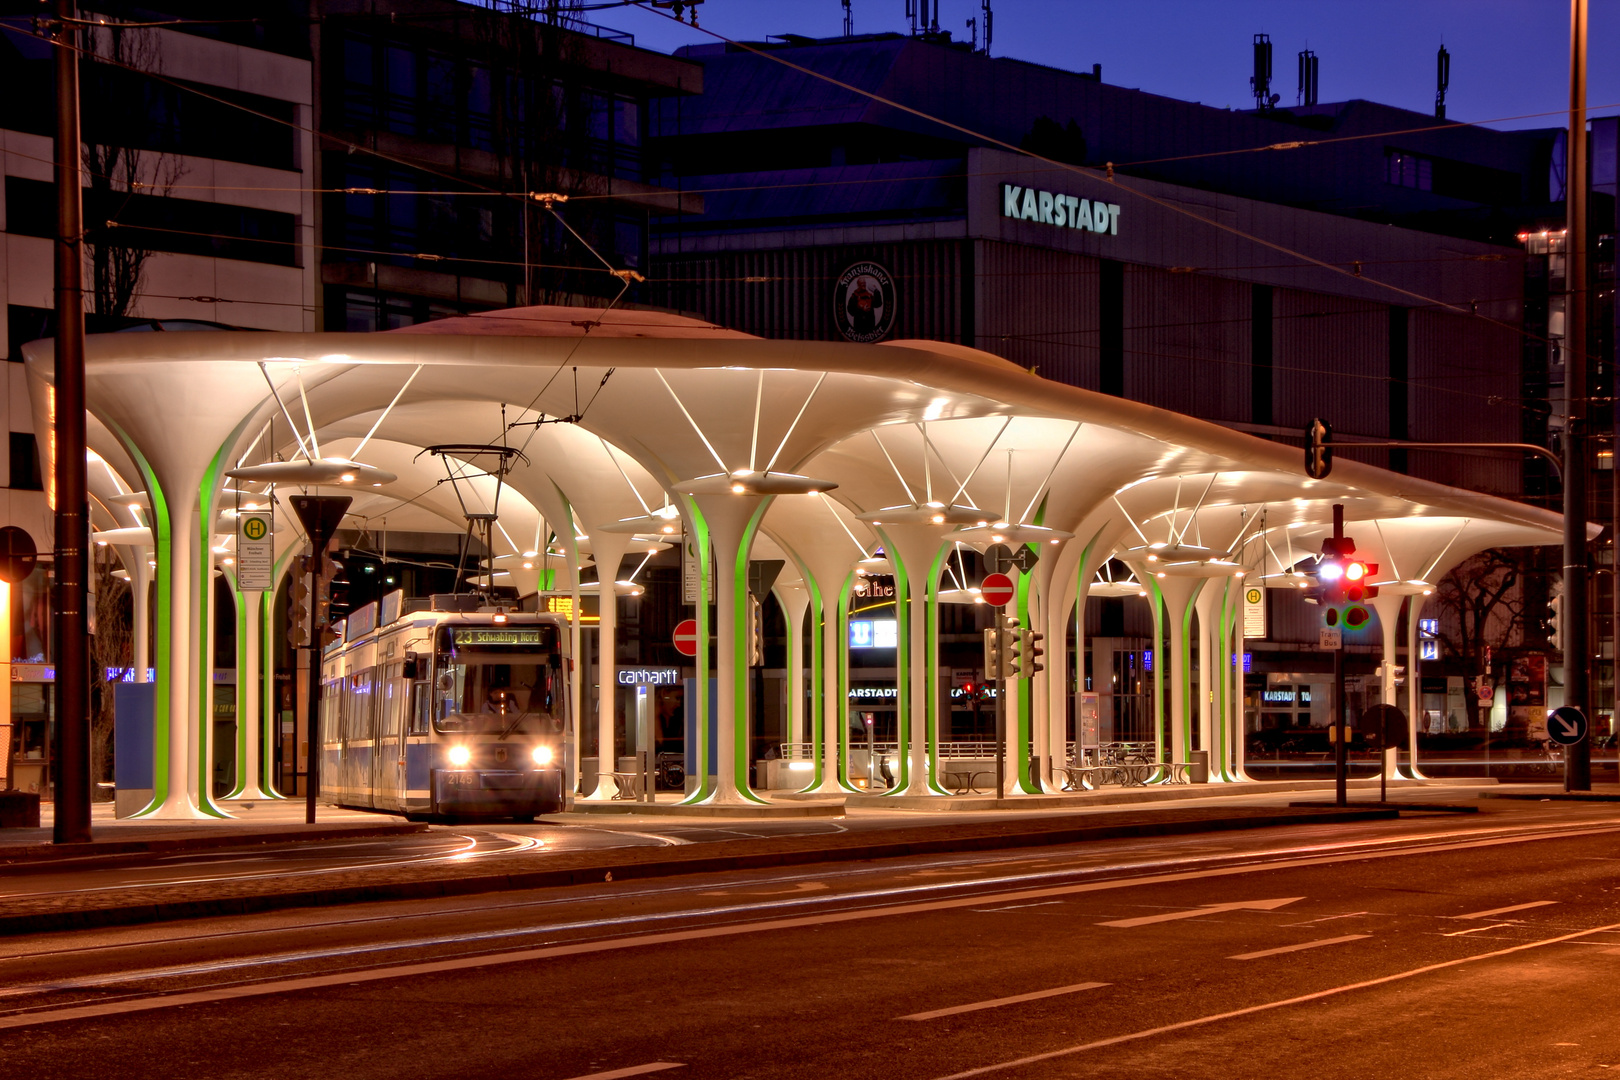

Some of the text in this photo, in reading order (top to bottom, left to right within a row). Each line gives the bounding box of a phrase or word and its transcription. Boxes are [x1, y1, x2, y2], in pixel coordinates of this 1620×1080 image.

[1005, 184, 1121, 236] KARSTADT
[840, 264, 890, 288] Franziskaner
[455, 631, 539, 644] 23 Schwabing Nord
[854, 623, 870, 644] U
[1324, 639, 1338, 647] Bus
[618, 669, 678, 684] carhartt
[1264, 691, 1296, 702] KARSTADT
[448, 774, 473, 784] 2145
